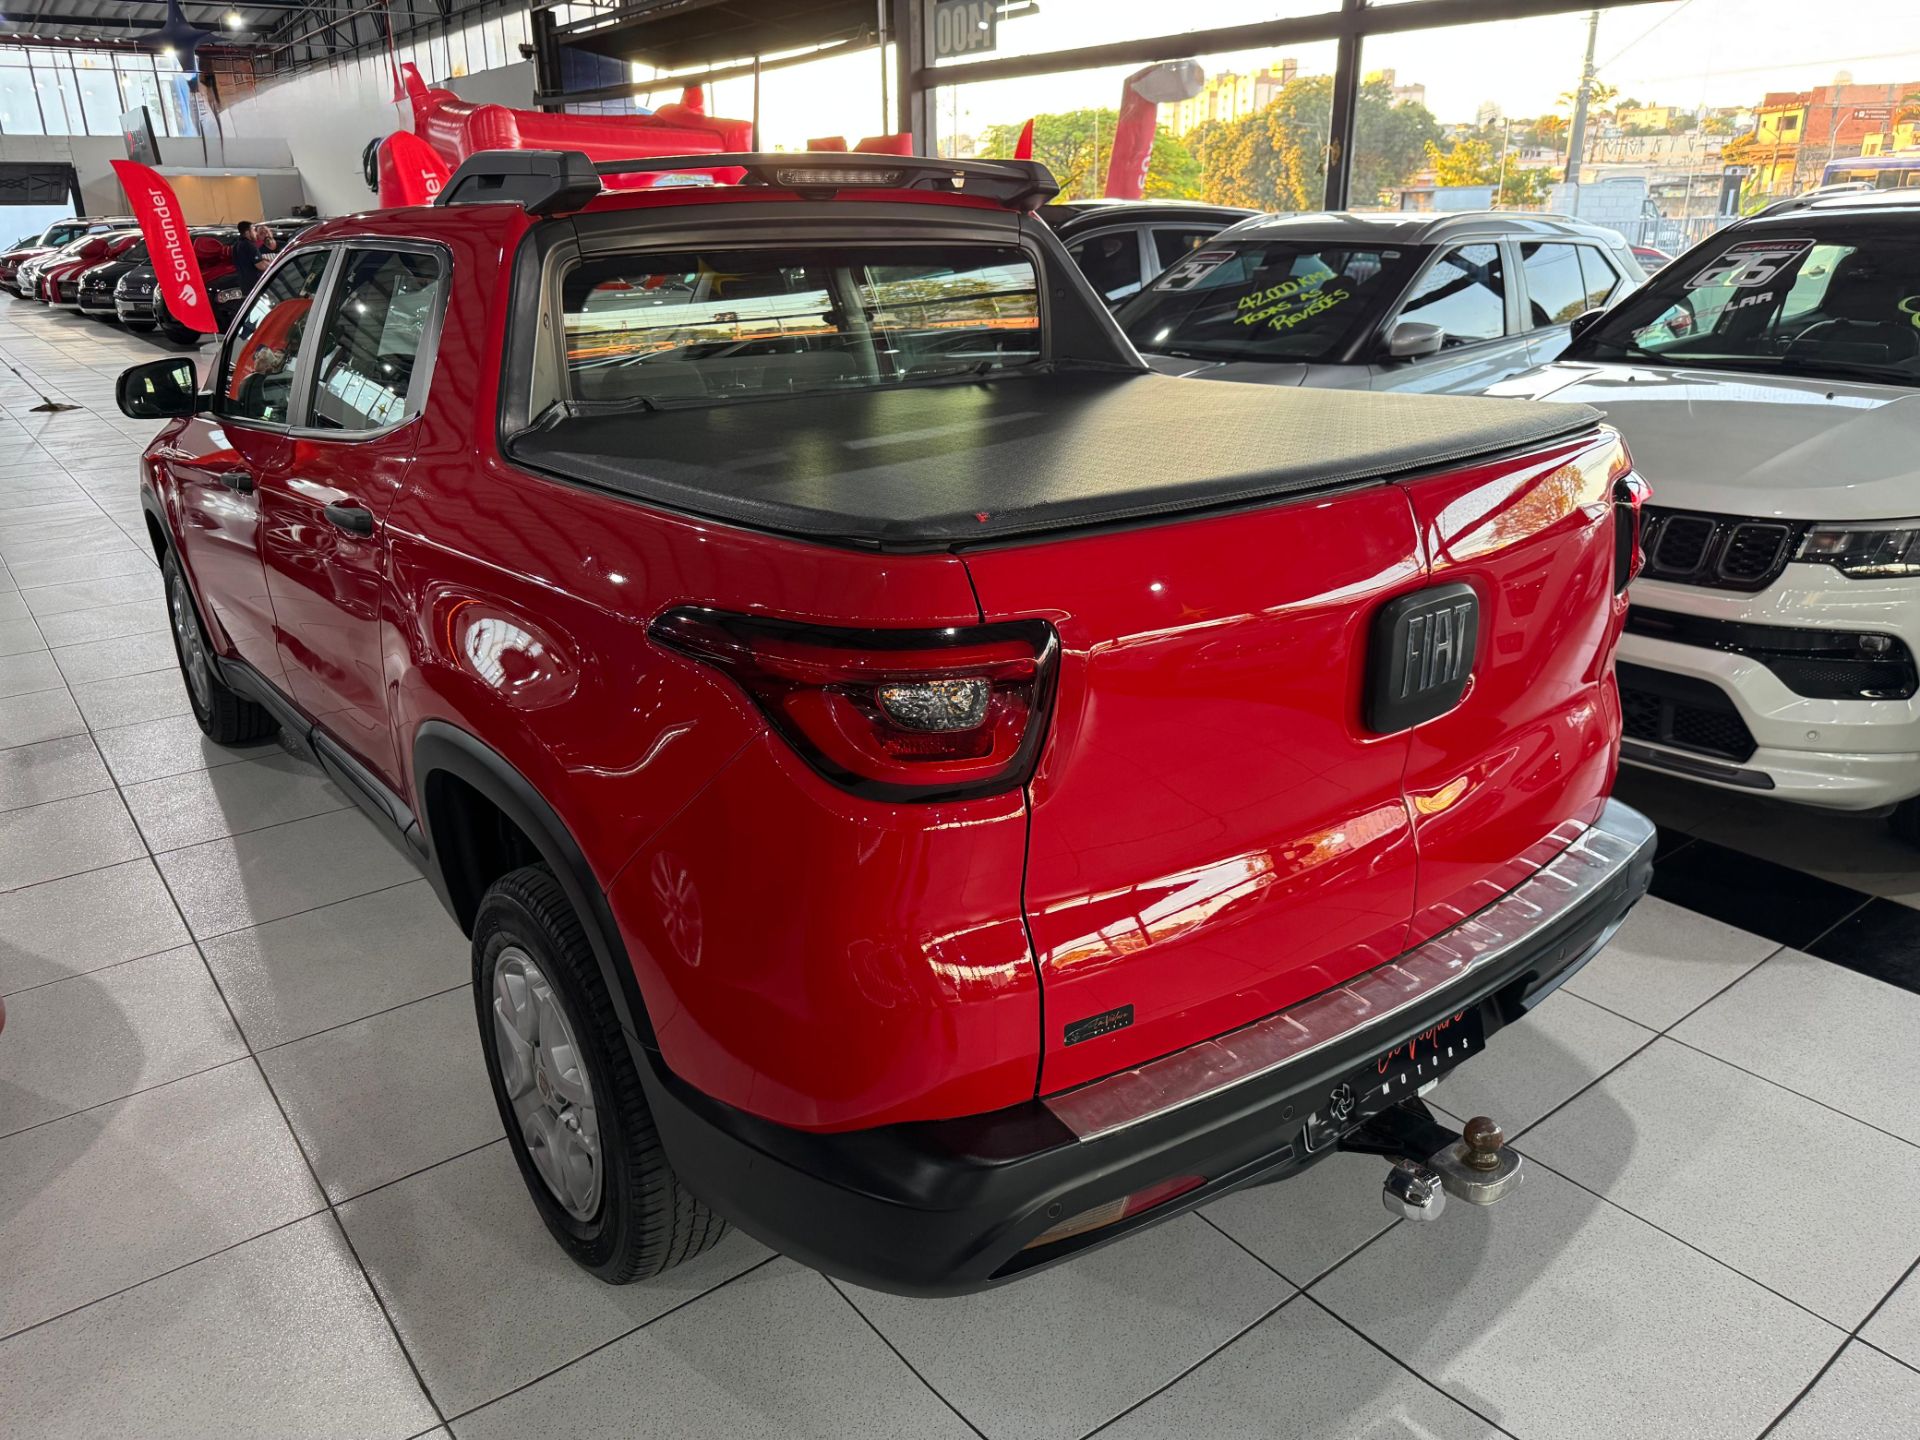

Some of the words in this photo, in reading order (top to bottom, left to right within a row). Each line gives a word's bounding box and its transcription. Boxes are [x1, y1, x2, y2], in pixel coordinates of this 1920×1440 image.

[148, 188, 191, 283] Santander
[1158, 263, 1217, 289] 24
[1692, 253, 1790, 285] 26
[1400, 602, 1473, 699] FIAT
[1382, 1038, 1469, 1095] MOTORS
